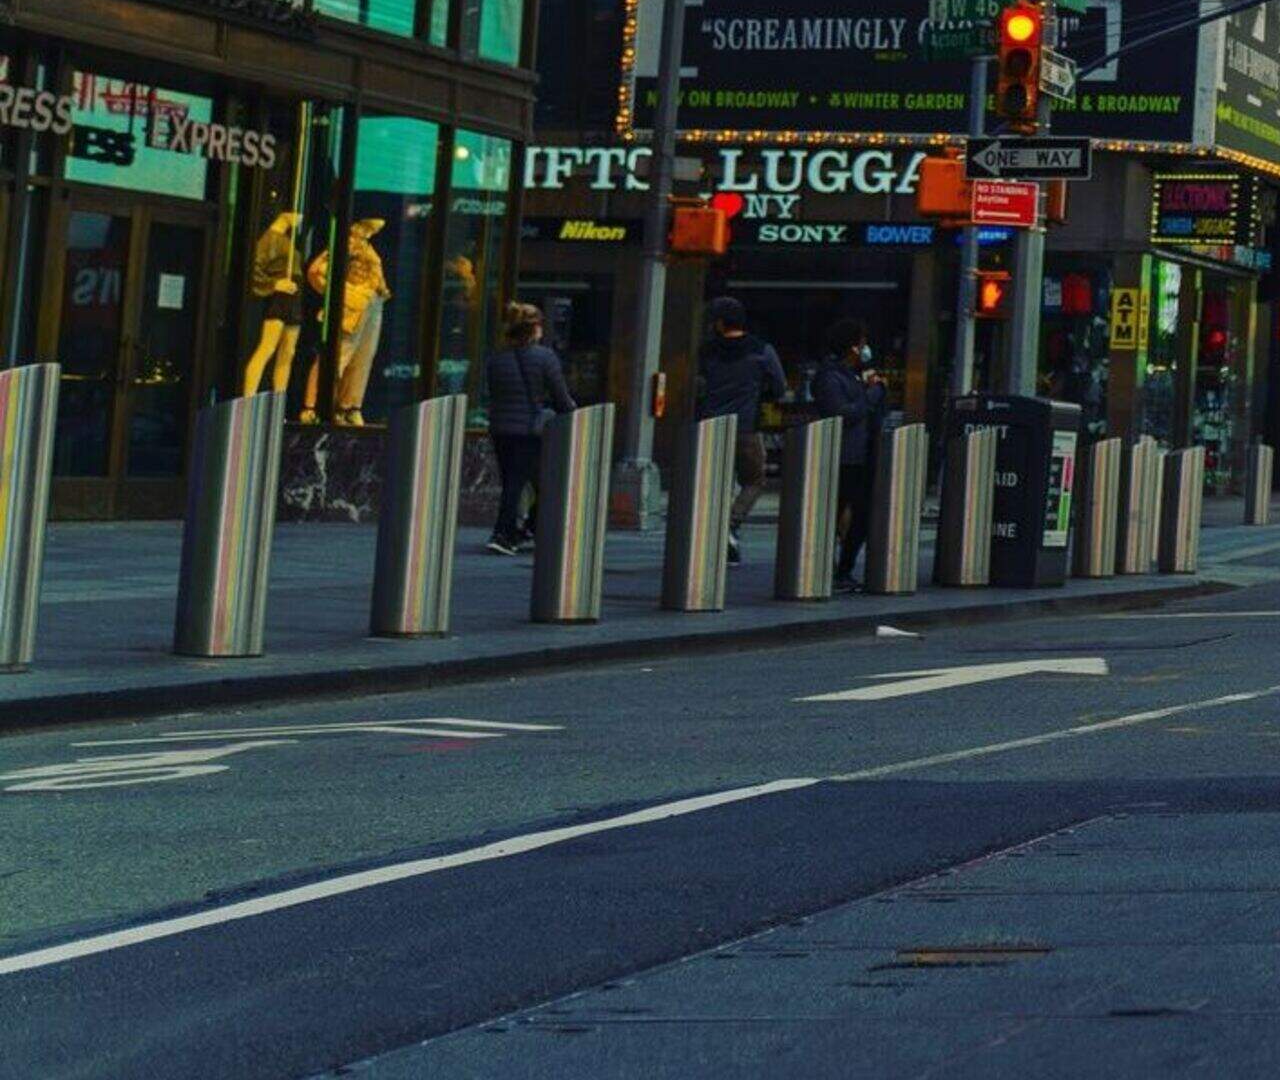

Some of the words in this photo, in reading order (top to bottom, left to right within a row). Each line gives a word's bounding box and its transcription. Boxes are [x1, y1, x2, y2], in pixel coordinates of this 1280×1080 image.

[688, 91, 711, 107] ON
[715, 91, 800, 109] BROADWAY
[844, 92, 900, 110] WINTER
[904, 93, 965, 111] GARDEN
[1081, 95, 1095, 111] &
[1098, 95, 1182, 113] BROADWAY
[151, 111, 277, 169] EXPRESS
[984, 150, 1020, 166] ONE
[1036, 150, 1073, 166] WAY
[524, 146, 653, 190] IFTS
[717, 149, 929, 194] LUGGA
[743, 193, 801, 219] NY
[558, 220, 627, 242] Nikon
[758, 224, 847, 243] SONY
[867, 225, 934, 244] BOWER
[1116, 292, 1134, 340] ATM
